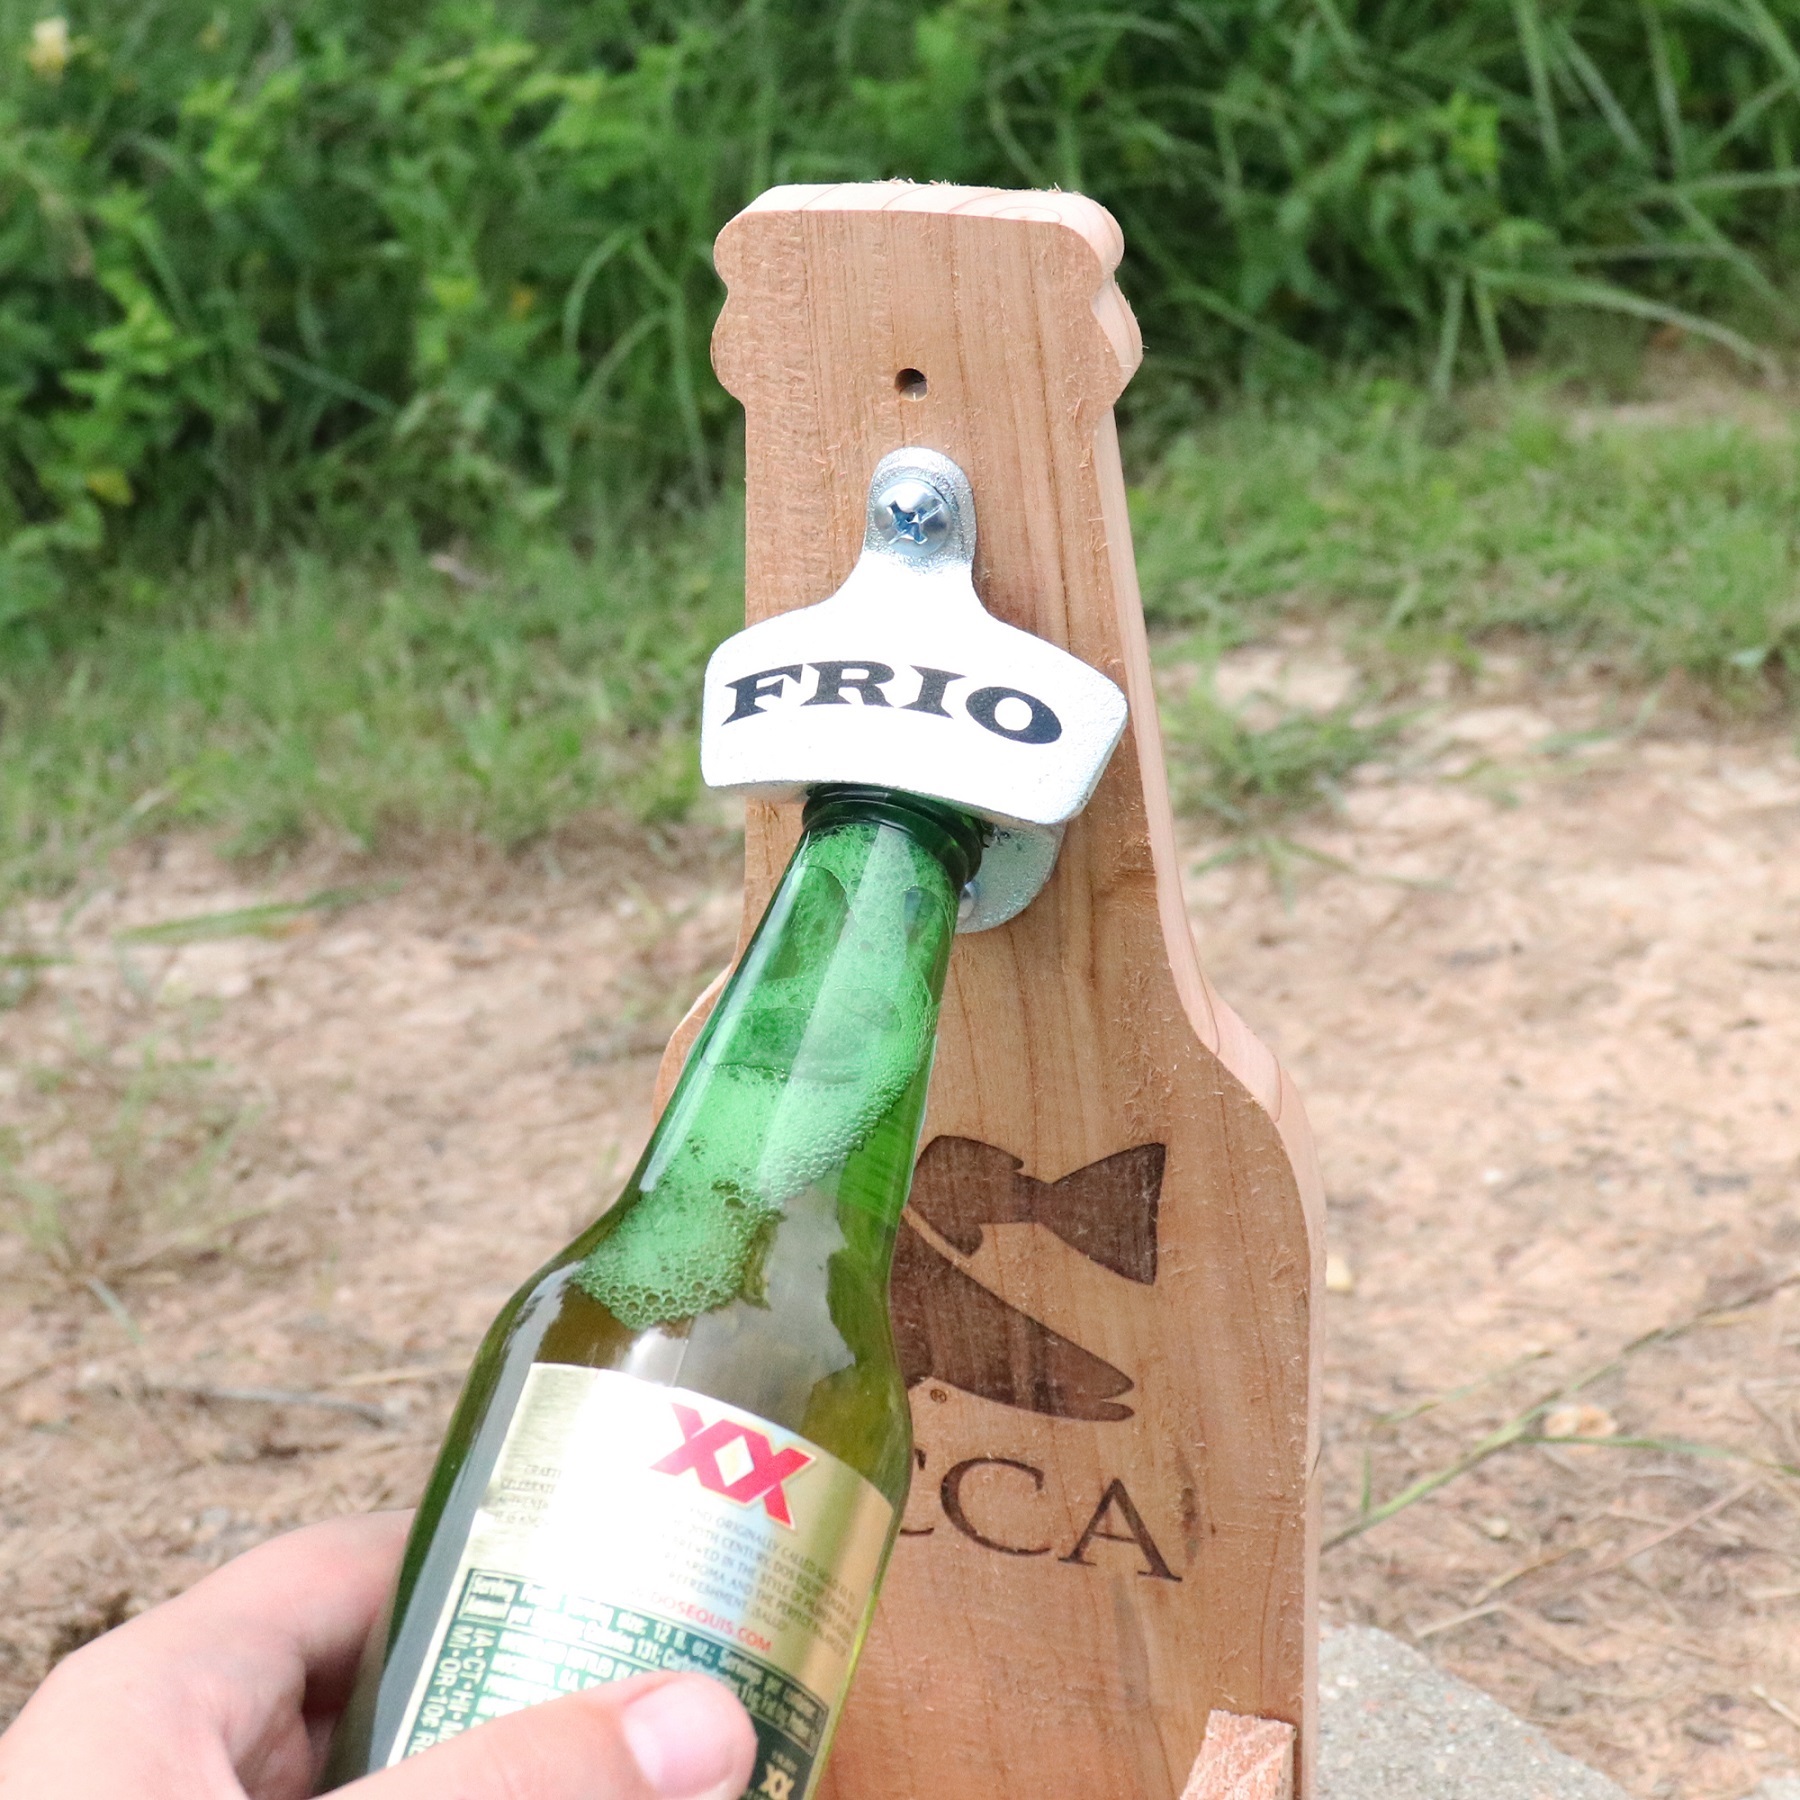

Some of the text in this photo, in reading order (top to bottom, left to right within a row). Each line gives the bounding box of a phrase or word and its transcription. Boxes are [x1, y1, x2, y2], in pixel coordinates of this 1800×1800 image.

[721, 660, 1063, 745] FRIO
[648, 1402, 817, 1530] XX
[899, 1448, 1183, 1583] CA
[651, 1621, 672, 1643] 12
